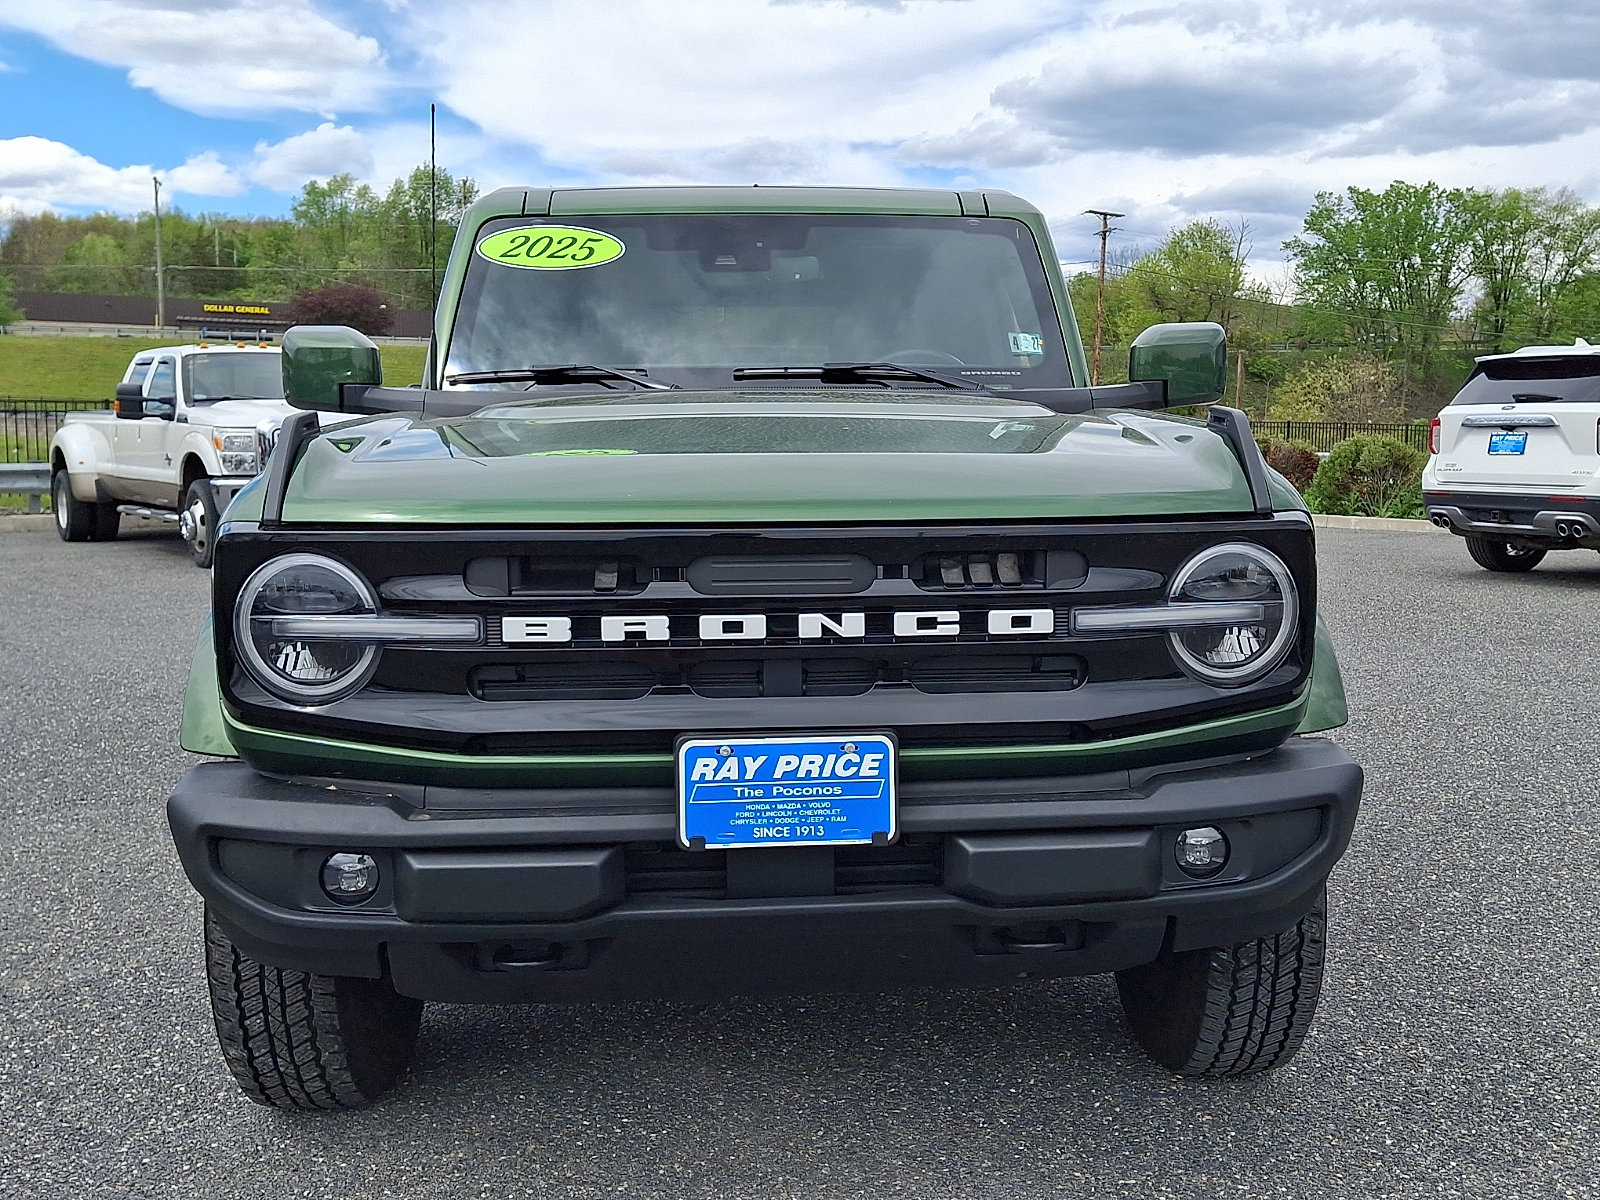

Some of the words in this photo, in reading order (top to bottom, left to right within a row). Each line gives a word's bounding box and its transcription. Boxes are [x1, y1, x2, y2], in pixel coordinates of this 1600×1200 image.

[498, 235, 604, 262] 2025
[203, 304, 235, 313] DOLLAR
[235, 305, 271, 315] GENERAL
[501, 608, 1055, 643] BRONCO
[690, 756, 769, 781] RAY
[772, 753, 885, 779] PRICE
[733, 787, 764, 798] The
[772, 785, 843, 796] Poconos
[799, 808, 841, 816] CHEVROLET
[730, 818, 768, 826] CHRYSLER
[753, 826, 791, 838] SINCE
[795, 825, 825, 837] 1913
